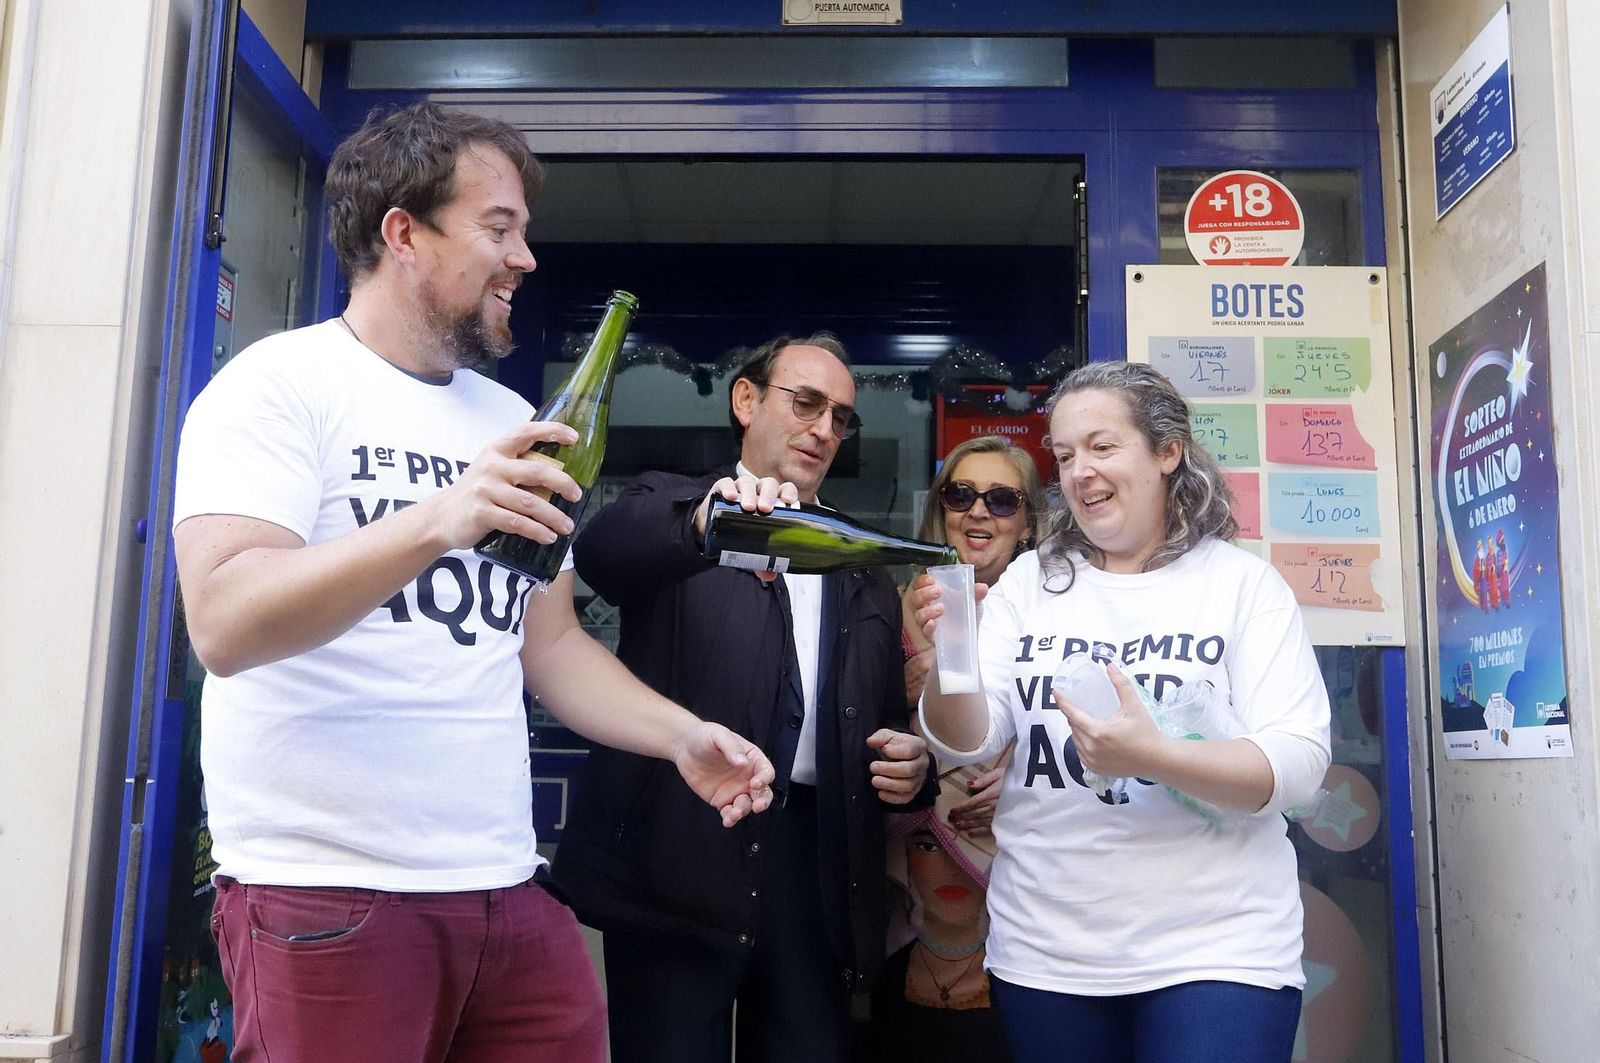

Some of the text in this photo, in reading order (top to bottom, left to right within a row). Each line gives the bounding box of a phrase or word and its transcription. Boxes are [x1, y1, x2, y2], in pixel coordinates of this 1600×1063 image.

[814, 3, 890, 12] PUERTA AUTOMATICA
[1208, 182, 1273, 218] +18
[1211, 283, 1305, 319] BOTES
[1189, 359, 1231, 383] 17
[970, 425, 1029, 434] EL GORDO
[1464, 394, 1506, 438] SORTEO
[1301, 430, 1343, 457] 13'7
[1459, 421, 1514, 460] EXTRAORDINARIO DE
[350, 445, 396, 481] 1er
[1453, 442, 1522, 507] EL NIÑO
[1316, 487, 1345, 496] LUNES
[1300, 500, 1361, 524] 10.000
[1468, 493, 1517, 529] 6 DE ENERO
[1318, 557, 1354, 567] JUEVES
[1015, 634, 1057, 663] 1er
[1061, 633, 1225, 666] PREMIO
[1469, 626, 1523, 655] 700 MILLONES
[1478, 649, 1516, 669] EN PREMIOS
